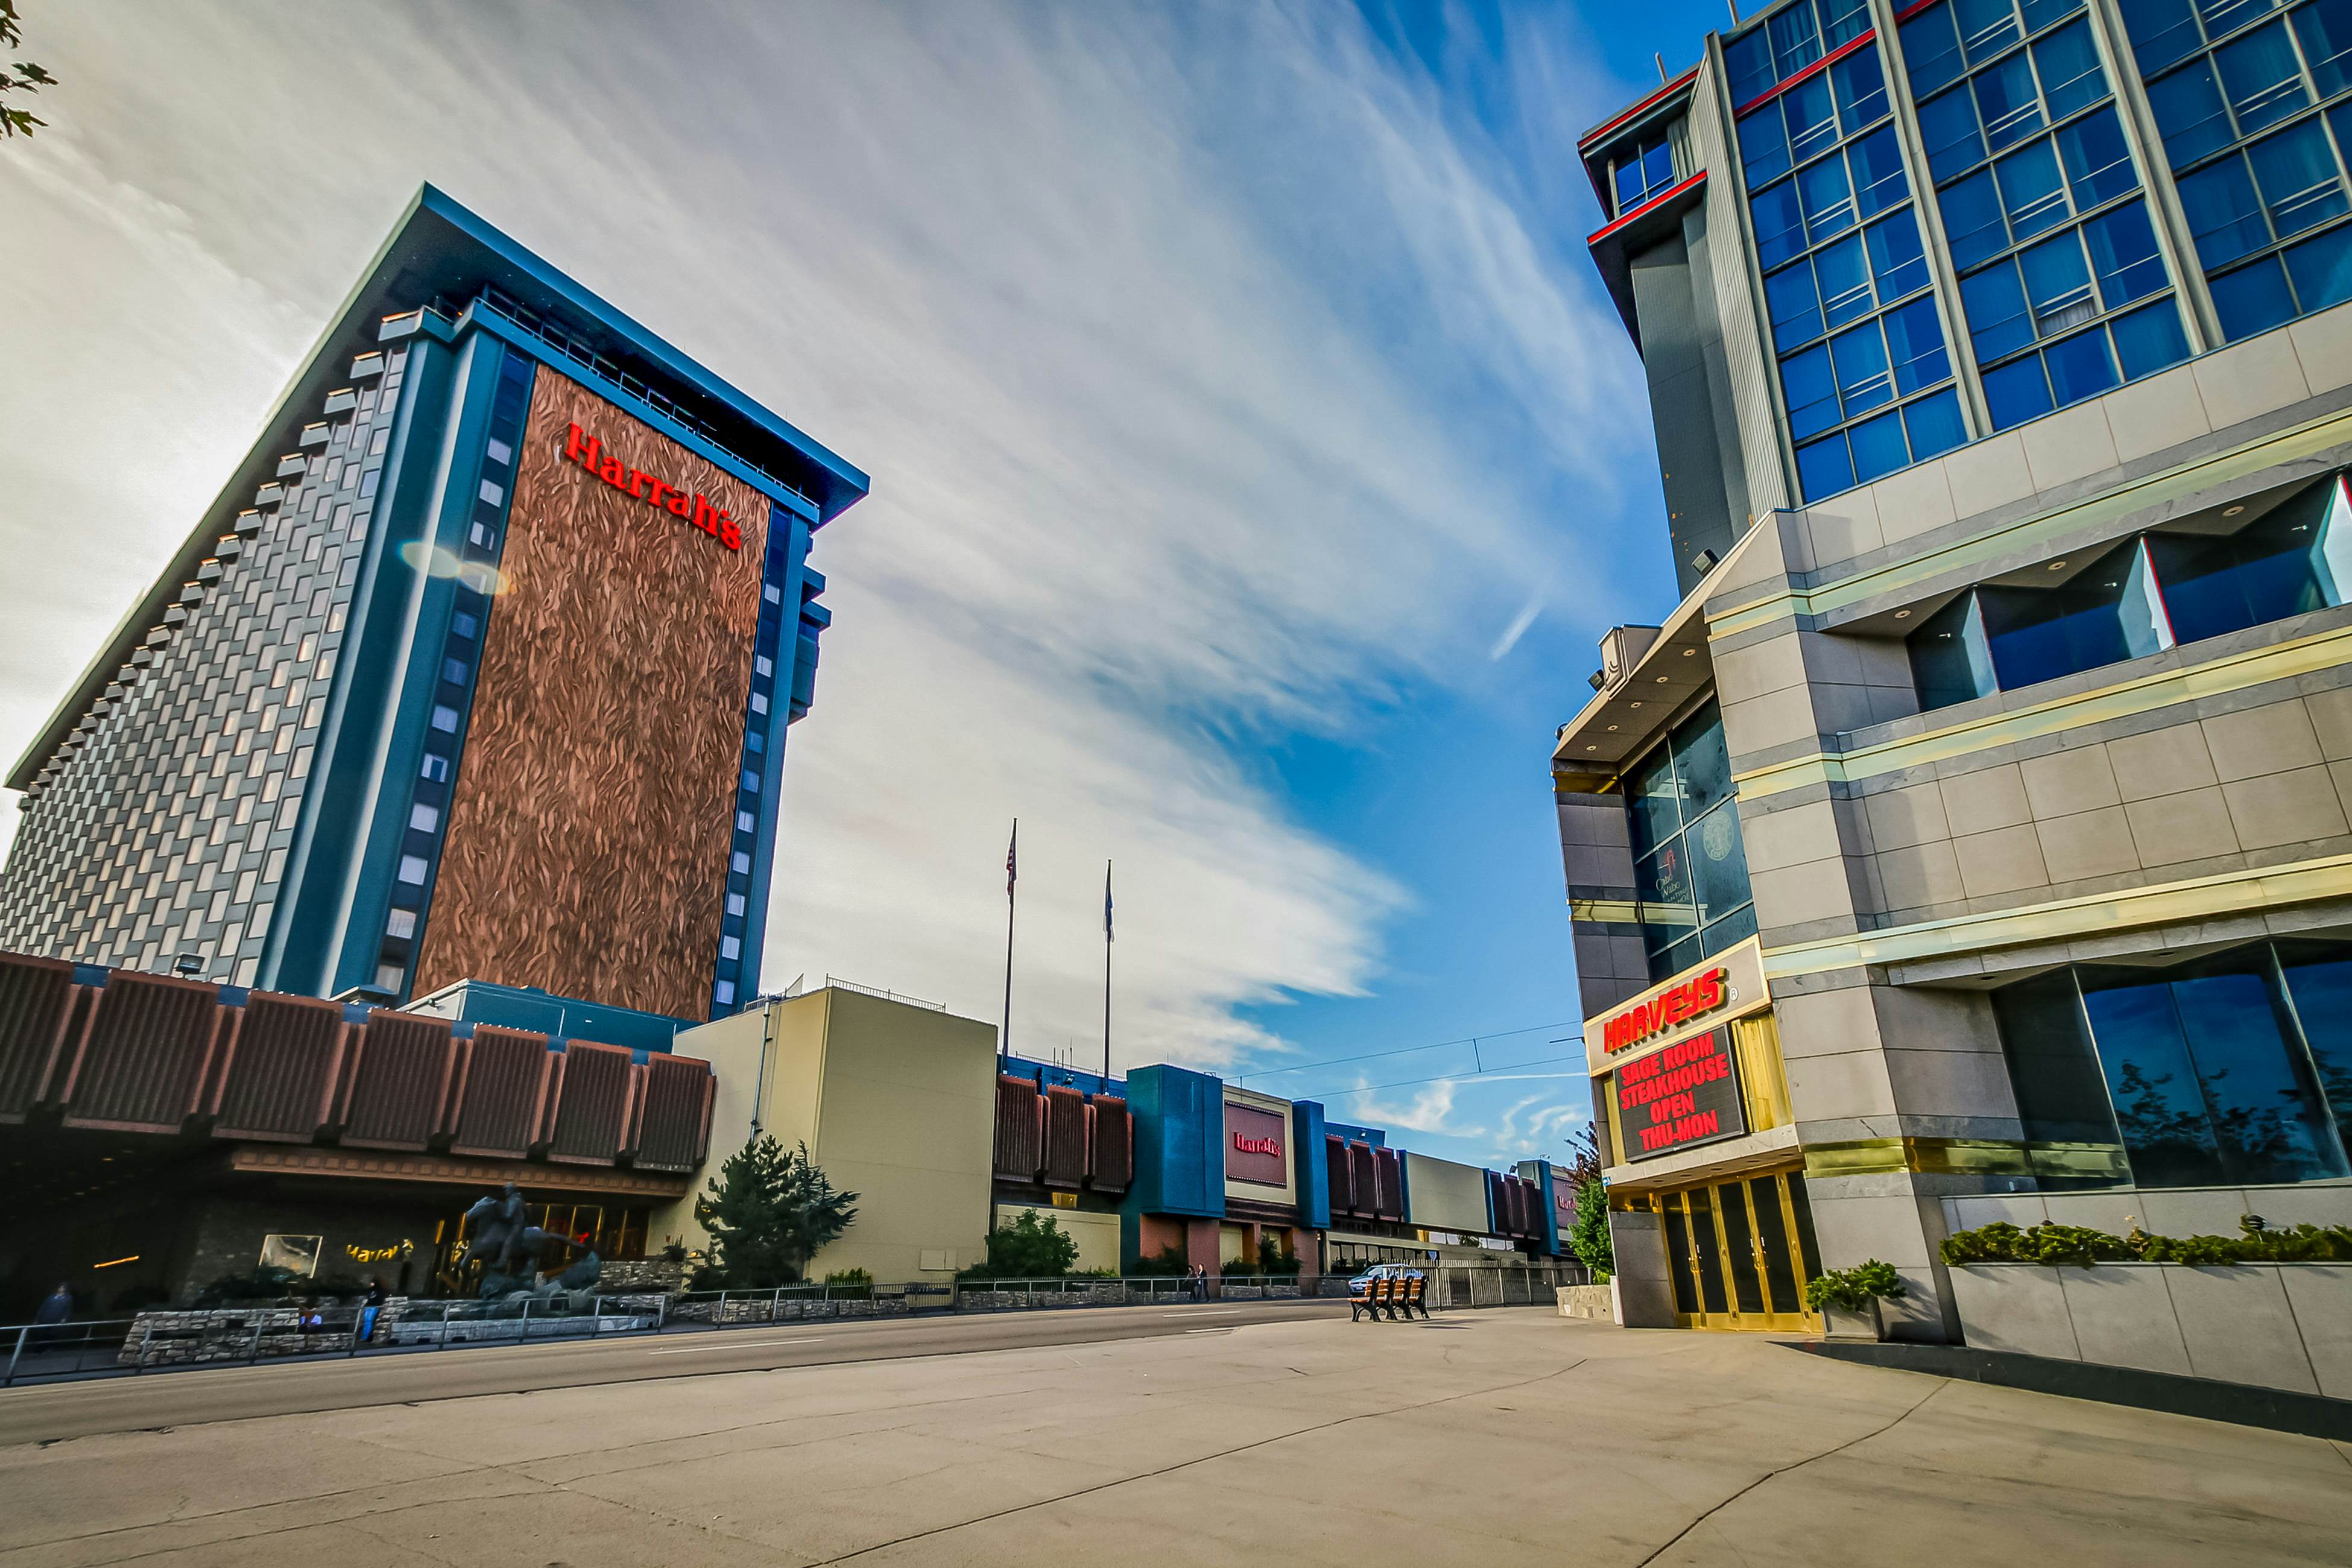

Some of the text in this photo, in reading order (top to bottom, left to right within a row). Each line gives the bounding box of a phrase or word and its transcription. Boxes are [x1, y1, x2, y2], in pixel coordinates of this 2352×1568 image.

[564, 422, 741, 551] Harrah's
[1604, 967, 1725, 1054] HARVEYS
[1620, 1032, 1715, 1086] SAGE ROOM
[1620, 1053, 1729, 1110] STEAKHOUSE
[1639, 1110, 1719, 1151] THU-MON
[1650, 1090, 1695, 1124] OPEN
